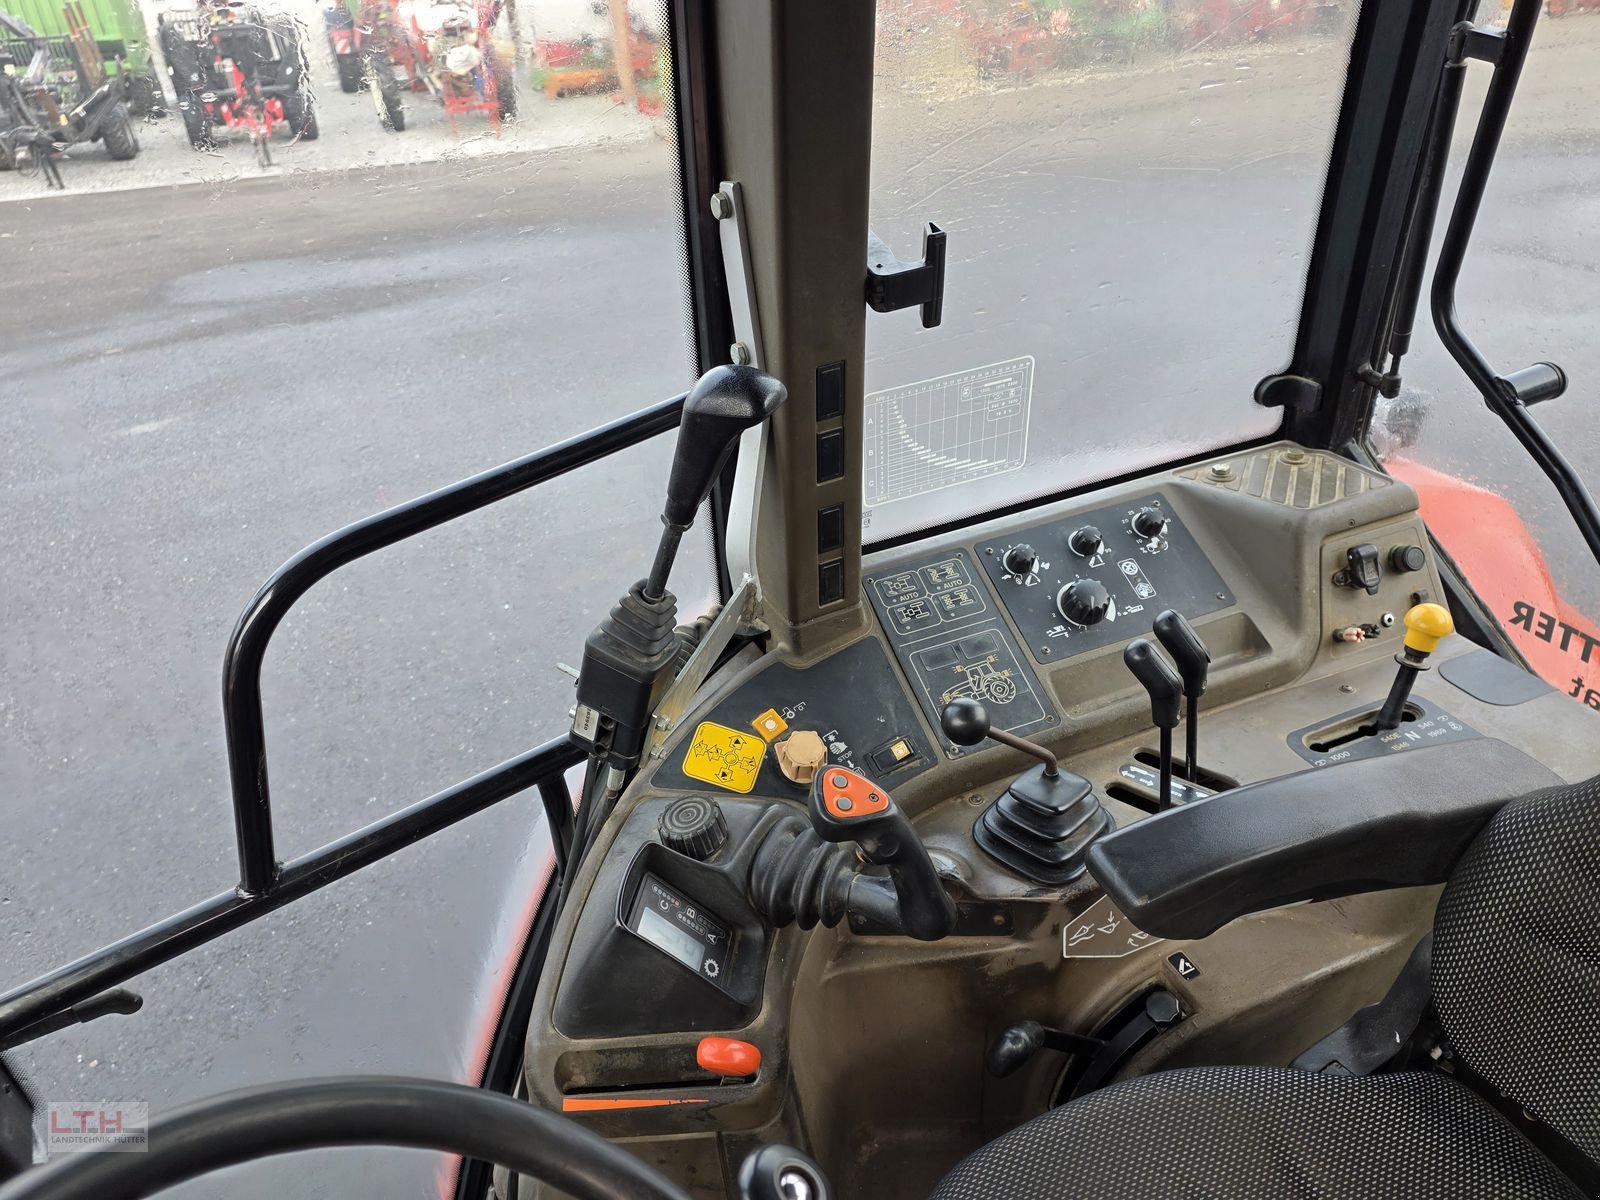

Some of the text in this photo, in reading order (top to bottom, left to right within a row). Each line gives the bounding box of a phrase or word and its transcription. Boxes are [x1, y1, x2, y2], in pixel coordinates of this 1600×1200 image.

[868, 449, 874, 457] B
[944, 579, 963, 589] AUTO
[899, 591, 919, 602] AUTO
[1404, 730, 1422, 741] N
[837, 750, 853, 763] STOP
[1329, 750, 1351, 761] 1000
[660, 899, 669, 910] C
[686, 907, 696, 919] B
[707, 933, 717, 944] A
